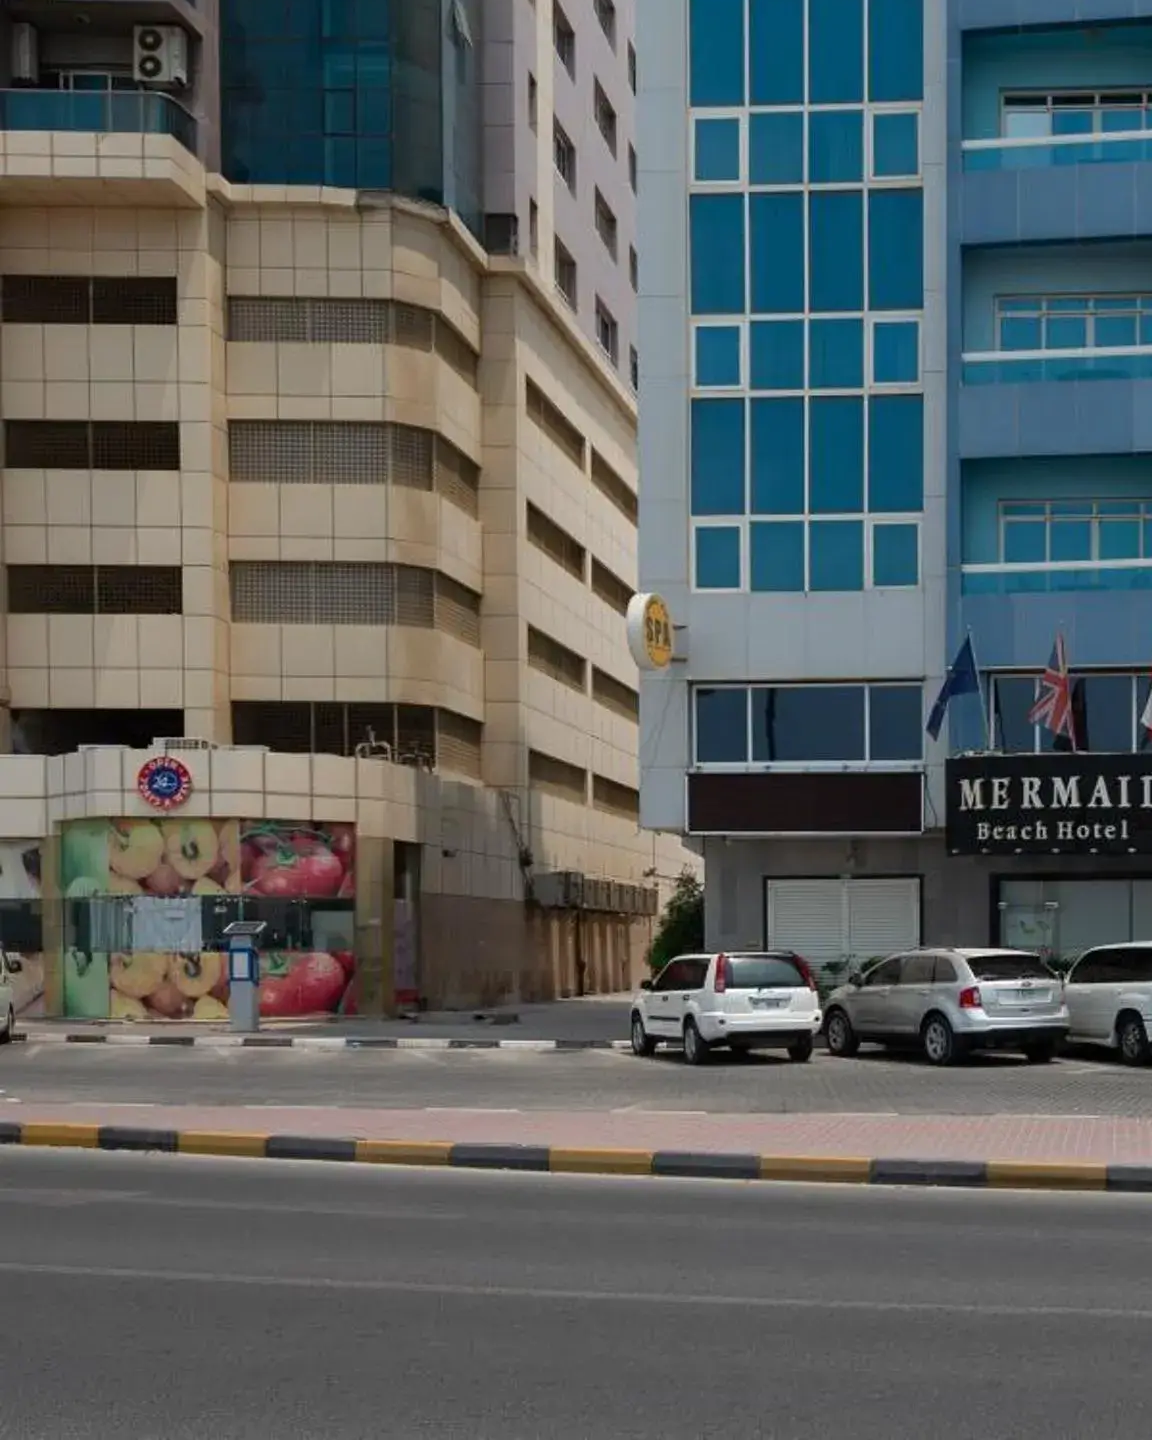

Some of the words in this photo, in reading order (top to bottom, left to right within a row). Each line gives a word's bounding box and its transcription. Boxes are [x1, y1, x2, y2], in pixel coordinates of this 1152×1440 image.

[645, 615, 672, 648] SPA
[977, 819, 1049, 840] Beach
[1056, 818, 1130, 840] Hotel
